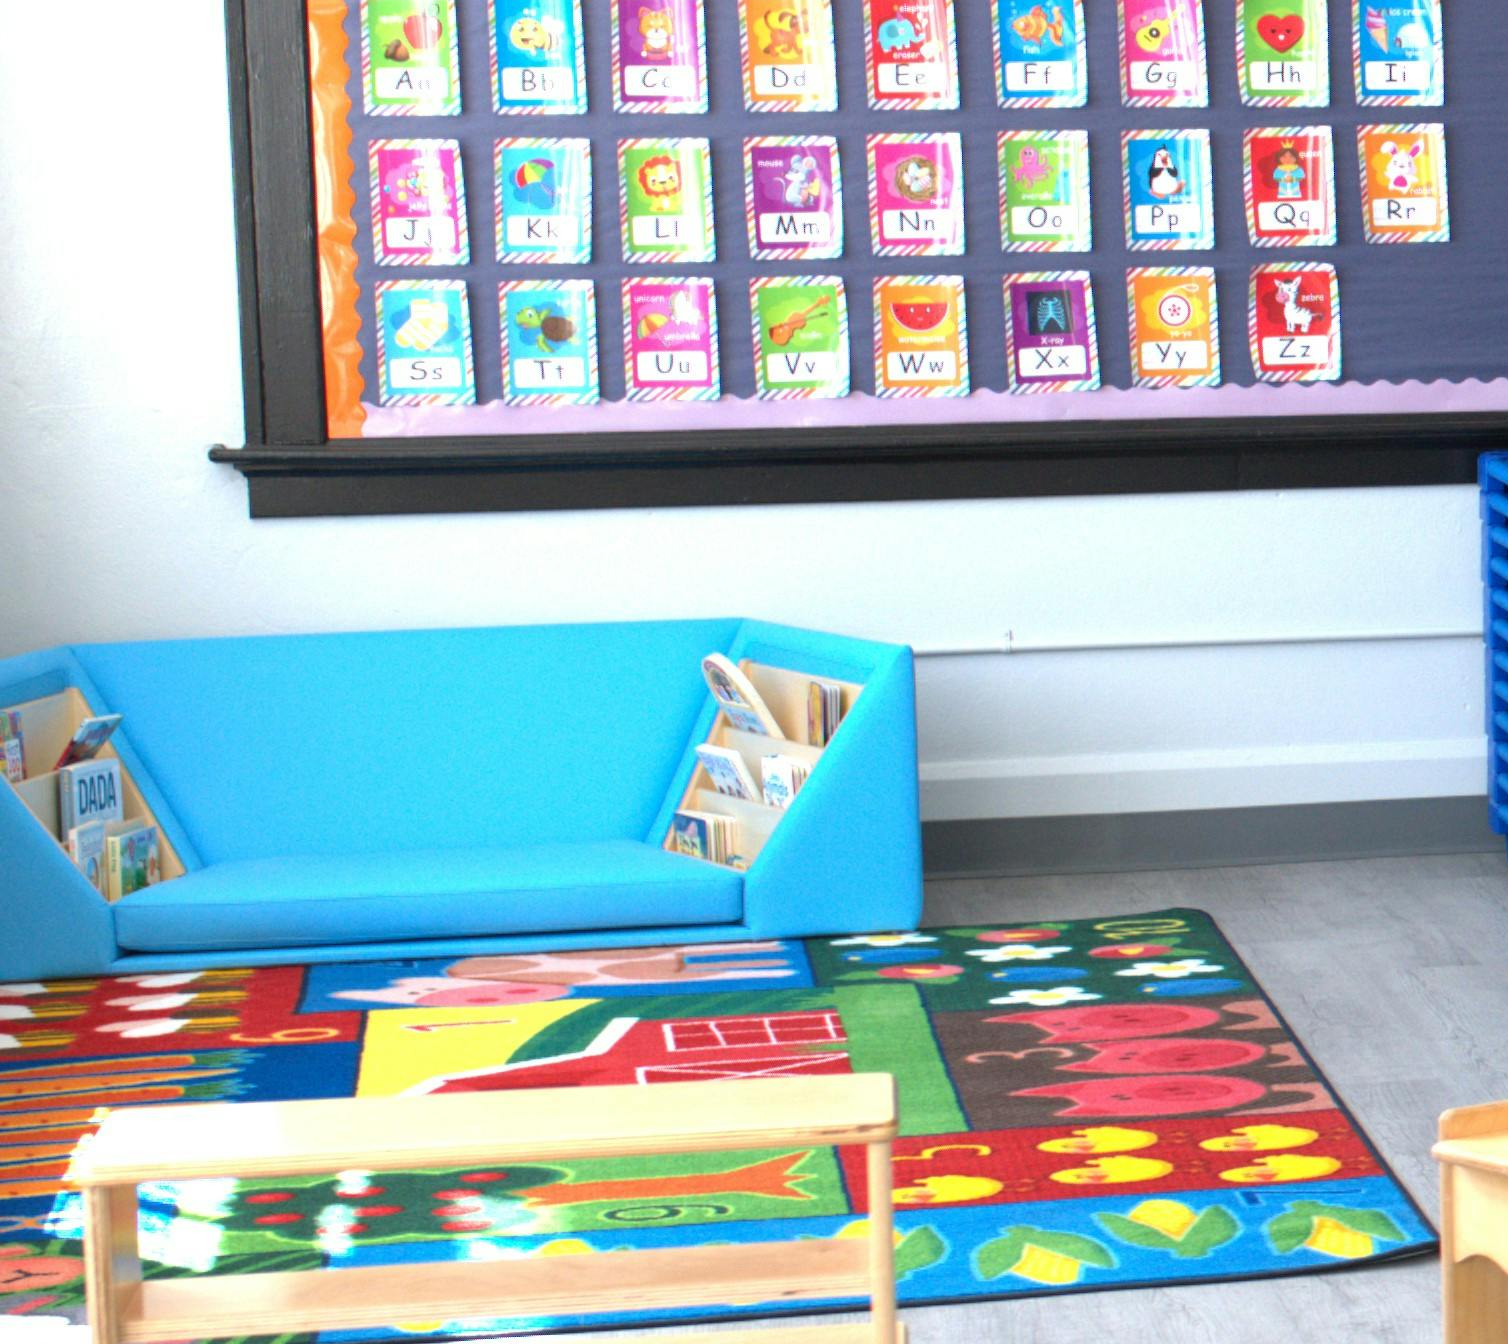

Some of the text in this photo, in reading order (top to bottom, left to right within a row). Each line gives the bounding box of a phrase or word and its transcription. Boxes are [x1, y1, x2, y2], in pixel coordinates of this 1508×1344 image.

[634, 295, 665, 304] unicorn
[1301, 293, 1324, 302] zebra
[78, 772, 116, 815] DADA
